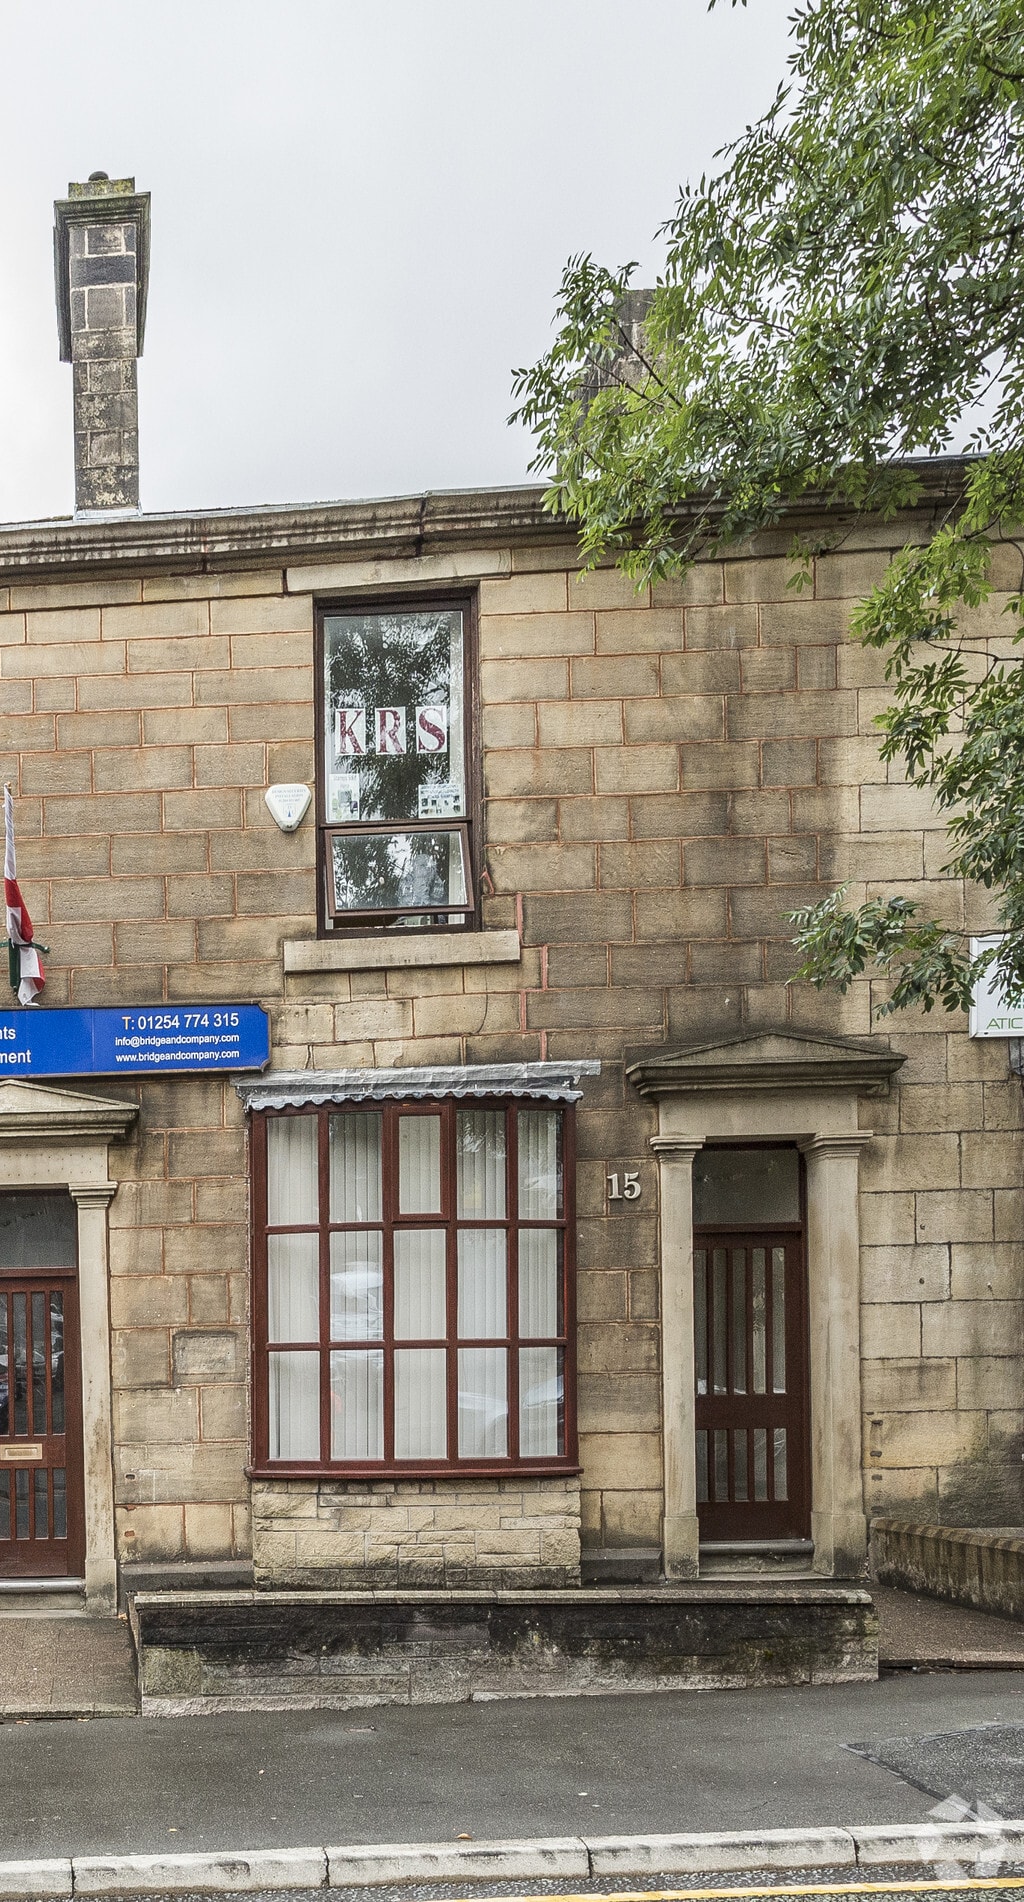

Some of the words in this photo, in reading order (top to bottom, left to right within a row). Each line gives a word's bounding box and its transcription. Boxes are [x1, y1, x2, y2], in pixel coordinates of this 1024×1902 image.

[337, 707, 446, 754] KRS
[121, 1016, 135, 1030] T:
[137, 1014, 180, 1030] 01254
[184, 1013, 209, 1028] 774
[213, 1012, 239, 1027] 315
[115, 1034, 240, 1047] info@bridgeandcompany.com
[115, 1050, 240, 1063] www.bridgeandcompany.com
[606, 1171, 641, 1199] 15
